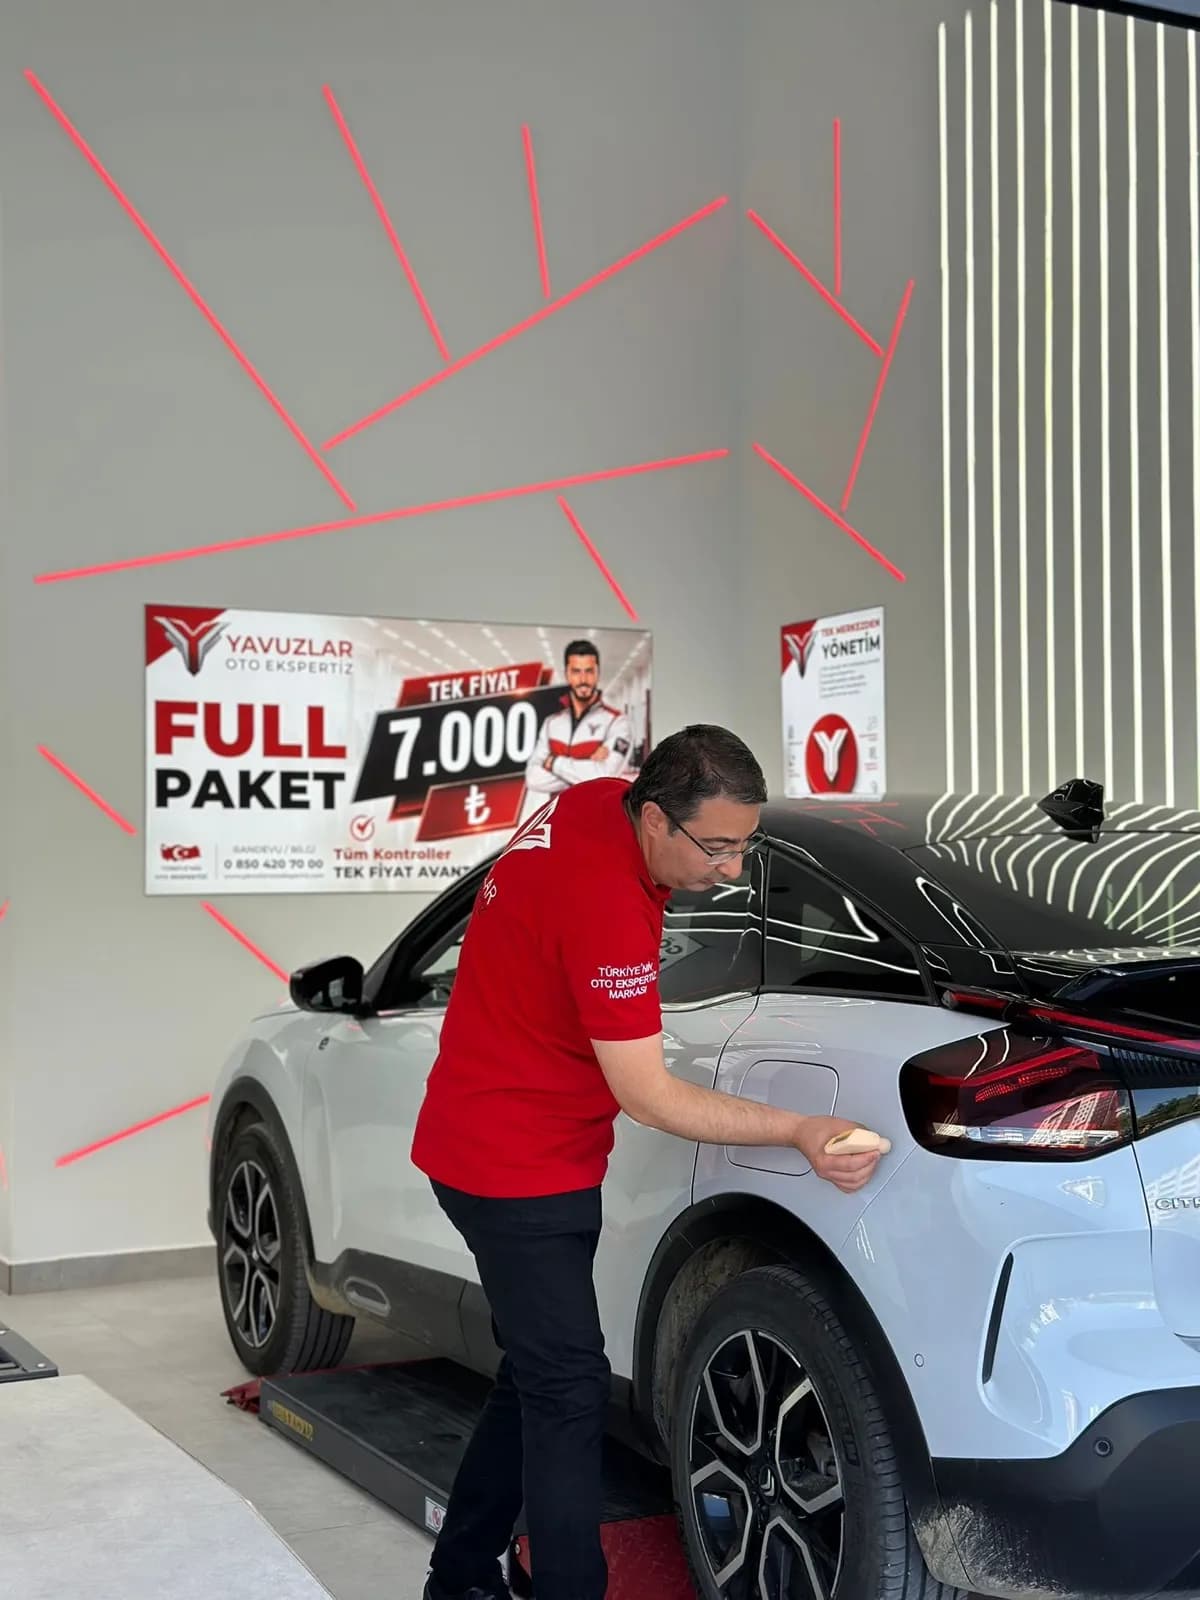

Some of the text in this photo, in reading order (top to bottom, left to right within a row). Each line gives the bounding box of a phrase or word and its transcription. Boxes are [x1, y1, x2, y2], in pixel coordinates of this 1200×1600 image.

[226, 635, 353, 658] YAVUZLAR
[821, 632, 880, 660] YÖNETİM
[225, 658, 353, 675] OTO EKSPERTİZ
[428, 670, 521, 701] TEK FİYAT
[155, 700, 347, 759] FULL
[389, 701, 538, 781] 7.000
[155, 769, 346, 810] PAKET
[223, 859, 324, 869] 0 850 420 70 00
[334, 848, 451, 860] Tüm Kontroller
[334, 866, 364, 878] TEK
[369, 863, 413, 878] FİYAT
[590, 979, 614, 989] OTO
[608, 985, 648, 999] MARKASI
